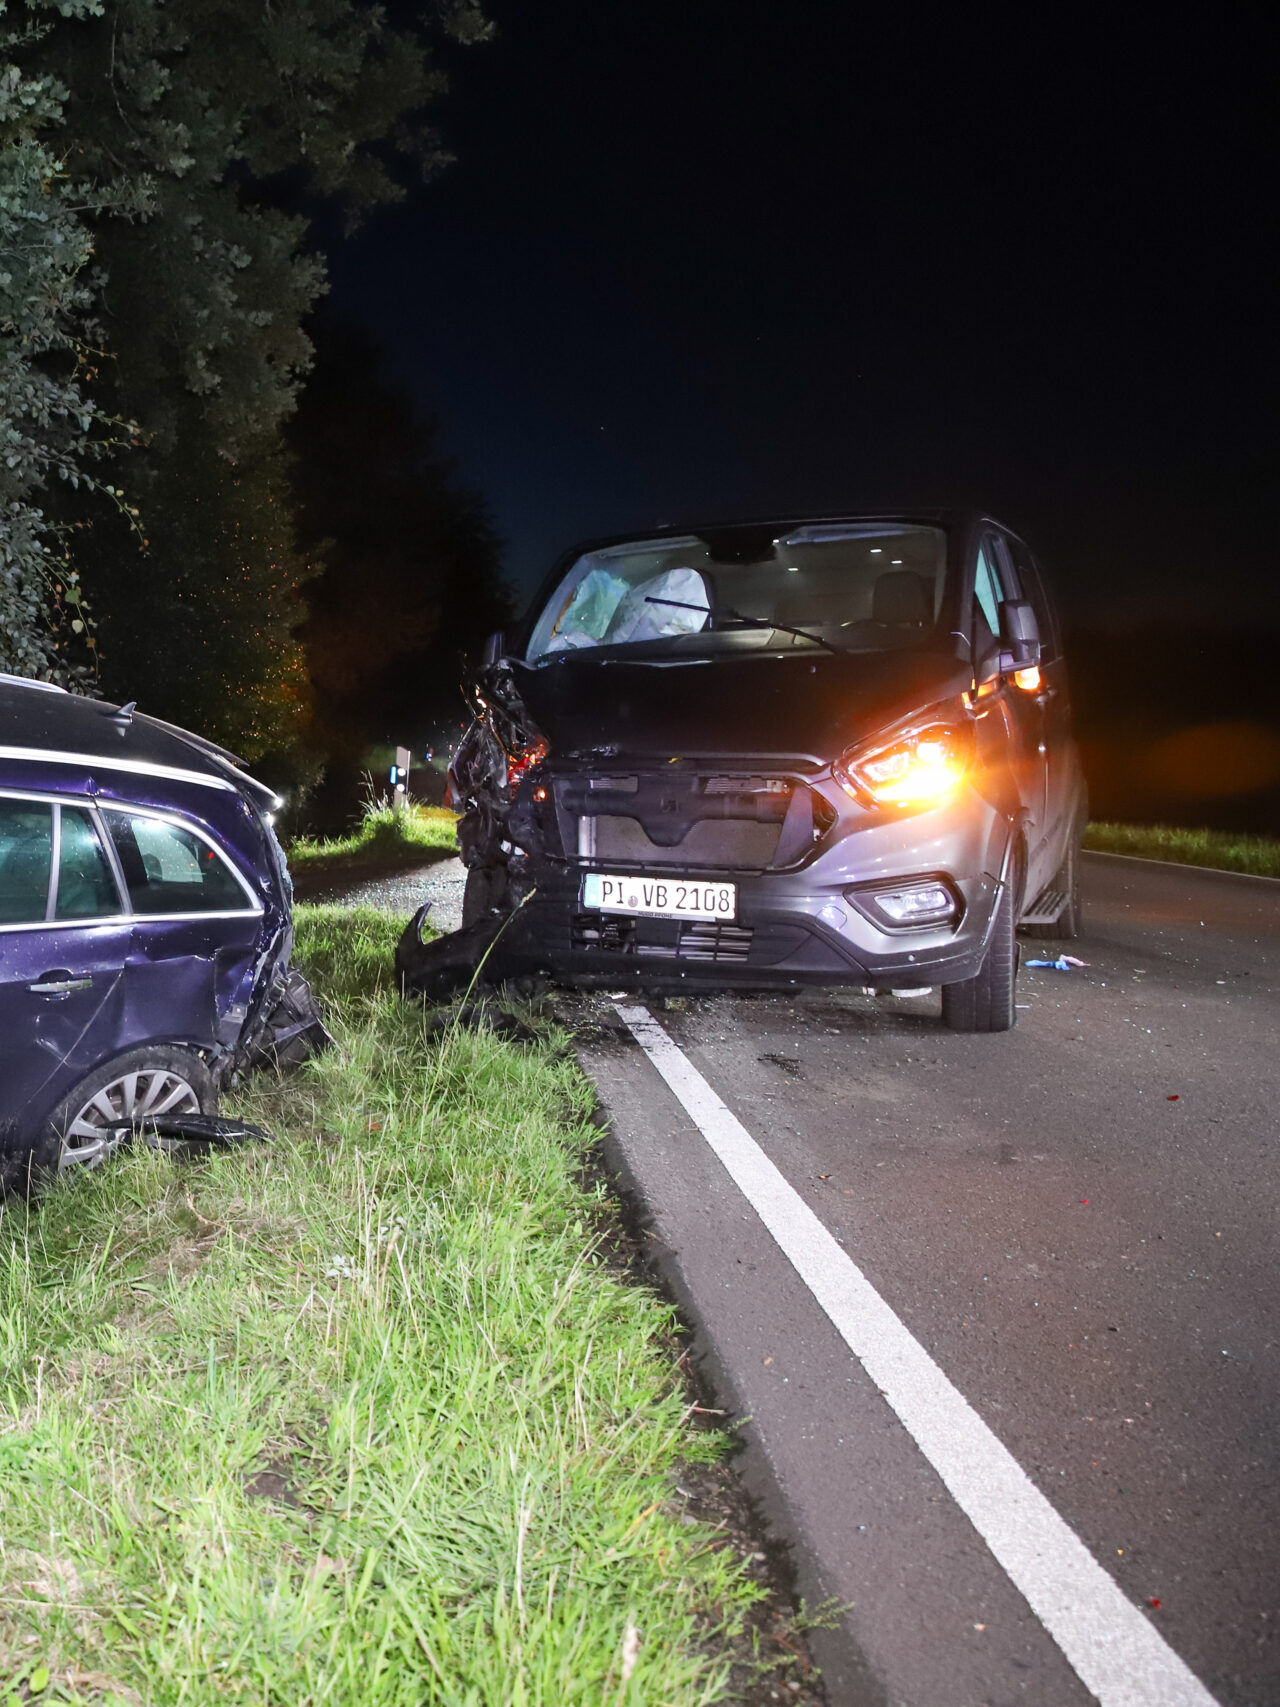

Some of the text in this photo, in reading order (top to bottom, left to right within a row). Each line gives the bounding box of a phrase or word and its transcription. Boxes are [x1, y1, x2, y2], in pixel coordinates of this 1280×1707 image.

[602, 880, 730, 913] PI VB 2108
